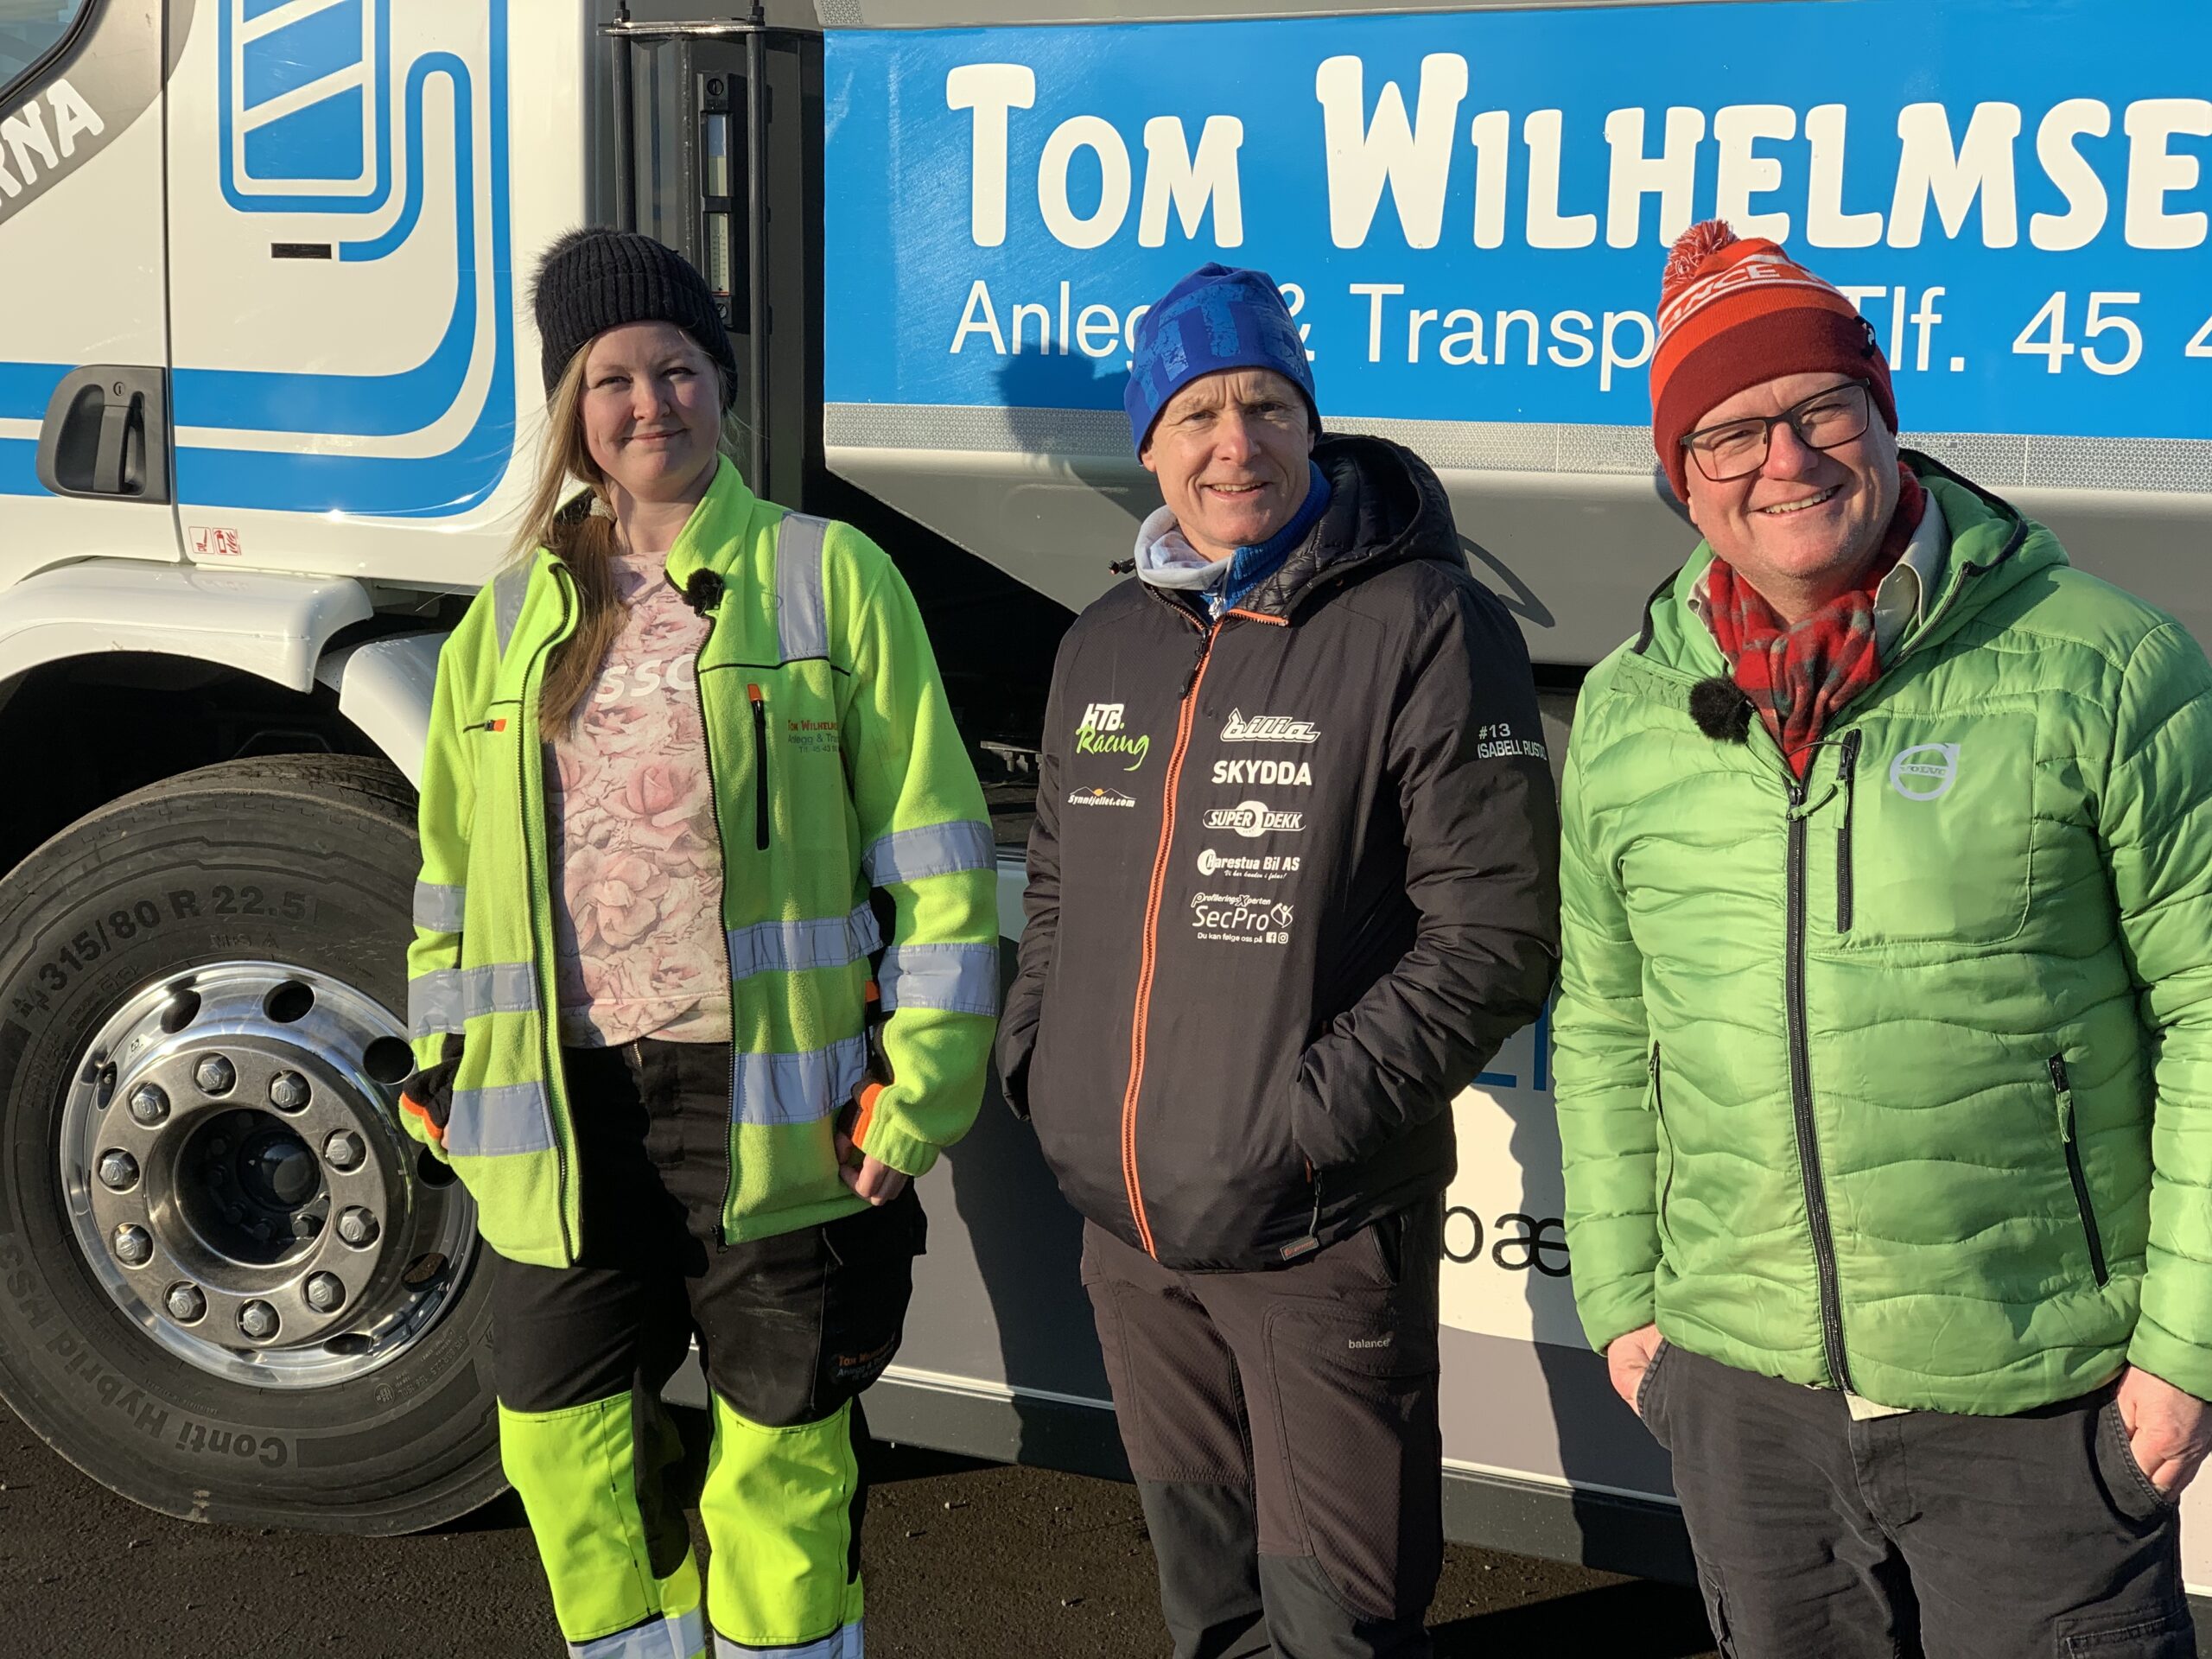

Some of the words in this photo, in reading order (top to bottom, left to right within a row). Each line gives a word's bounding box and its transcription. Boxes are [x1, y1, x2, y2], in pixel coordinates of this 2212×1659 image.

[1350, 283, 1655, 391] Transp
[2012, 291, 2143, 376] 45
[816, 734, 823, 742] &
[1478, 723, 1511, 740] #13
[1075, 723, 1149, 772] Racing
[1477, 740, 1522, 759] ISABELL
[1211, 760, 1313, 785] SKYDDA
[1209, 811, 1253, 827] SUPER
[1263, 813, 1303, 829] DEKK
[1262, 856, 1281, 871] Bil
[1282, 856, 1300, 872] AS
[1192, 906, 1269, 931] SecPro
[39, 899, 162, 993] 315/80
[173, 889, 200, 920] R
[212, 885, 306, 922] 22.5
[1209, 932, 1221, 941] kan
[1223, 933, 1240, 943] følge
[1254, 935, 1263, 944] på
[1348, 1338, 1390, 1349] balance
[45, 1333, 170, 1438] Hybrid
[175, 1420, 289, 1468] Conti
